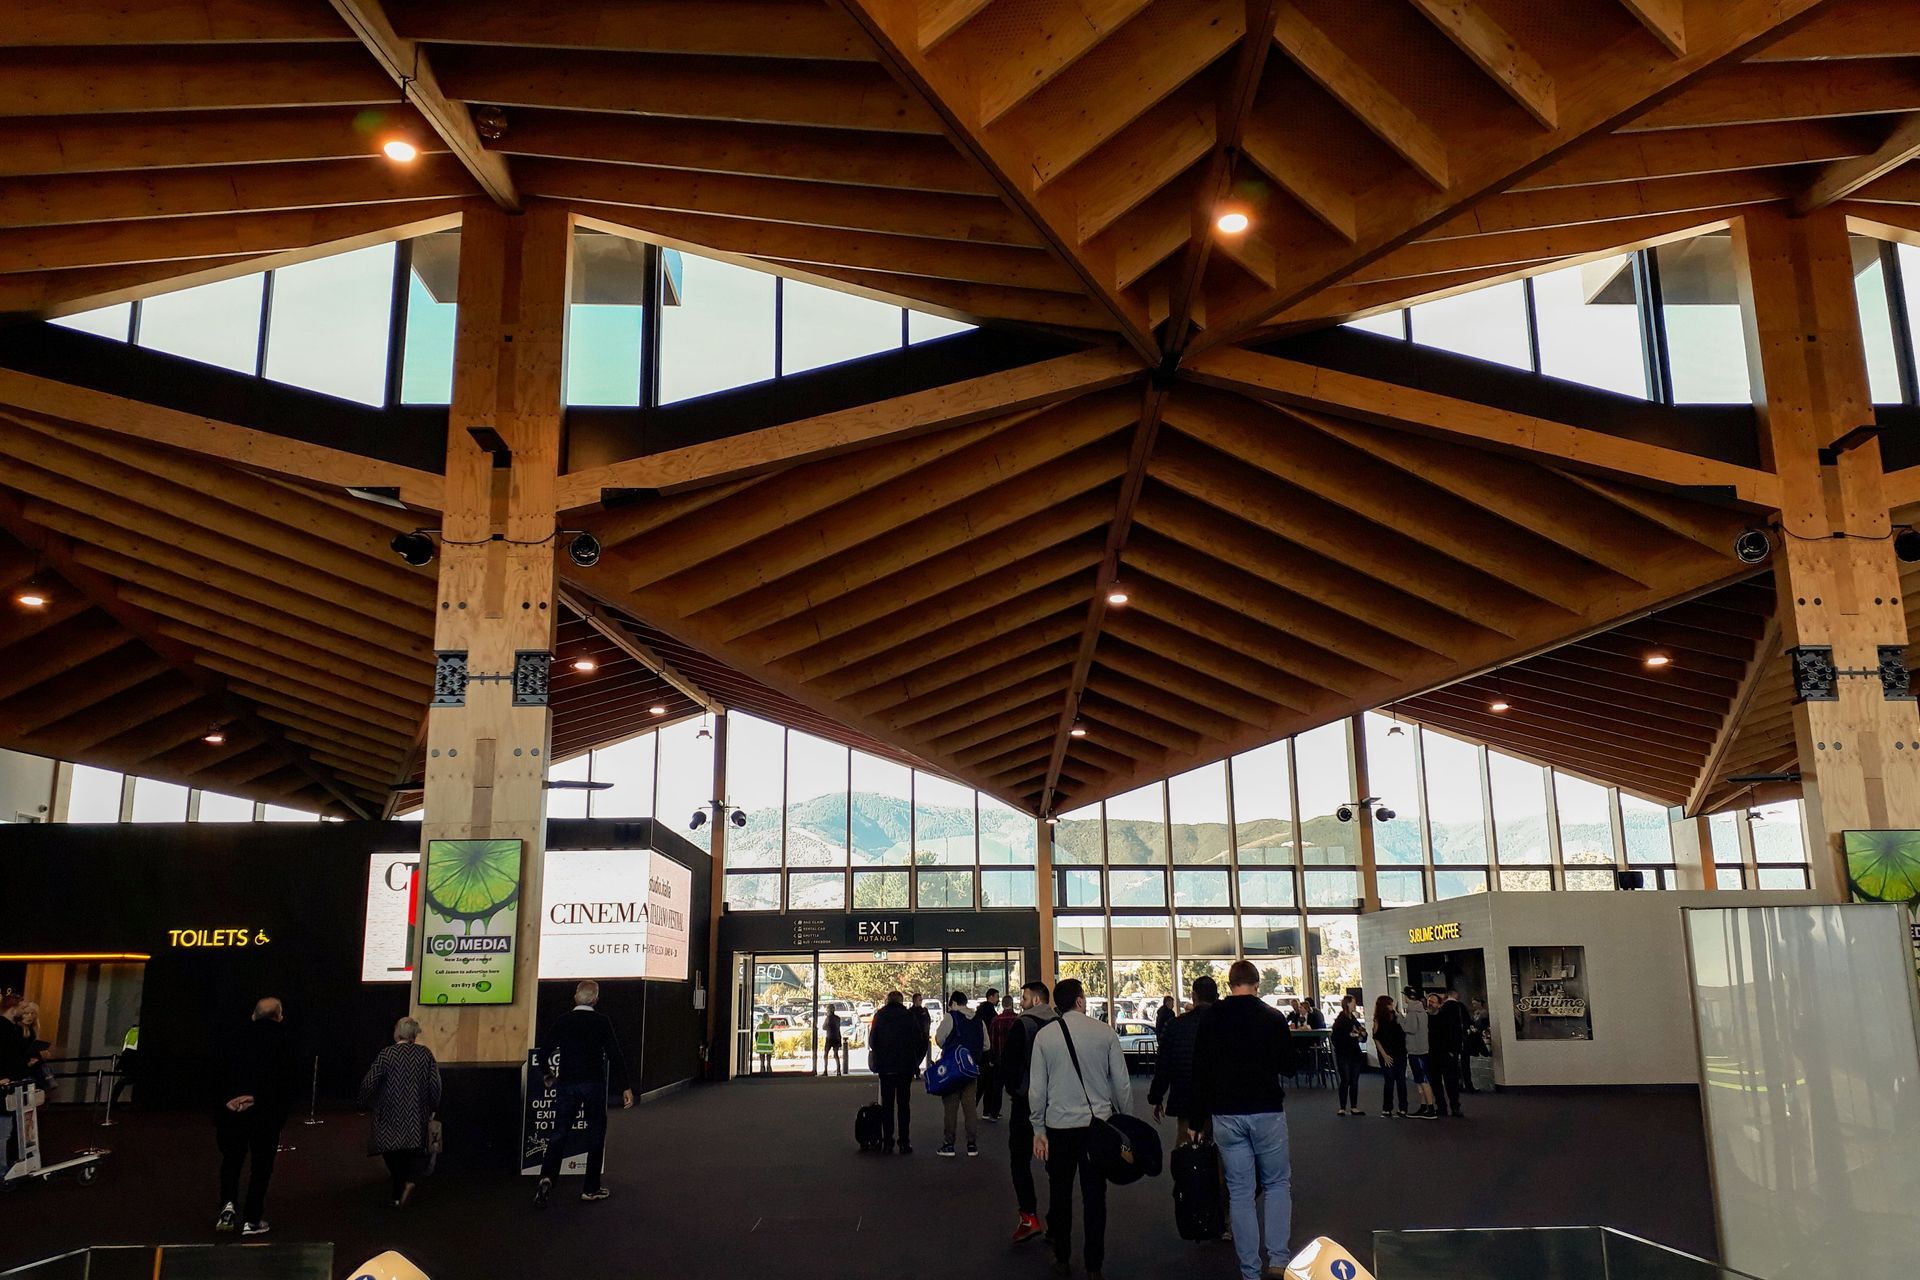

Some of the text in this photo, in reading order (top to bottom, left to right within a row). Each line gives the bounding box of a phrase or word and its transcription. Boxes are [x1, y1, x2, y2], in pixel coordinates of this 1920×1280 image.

[550, 902, 649, 924] CINEMA
[858, 921, 899, 935] EXIT
[1409, 922, 1460, 944] SUBLIME COFFEE
[168, 929, 248, 947] TOILETS
[434, 938, 508, 951] GO MEDIA
[589, 944, 630, 954] SUTER
[1517, 993, 1585, 1012] Sublime
[532, 1100, 552, 1109] OUT
[535, 1121, 548, 1130] TO
